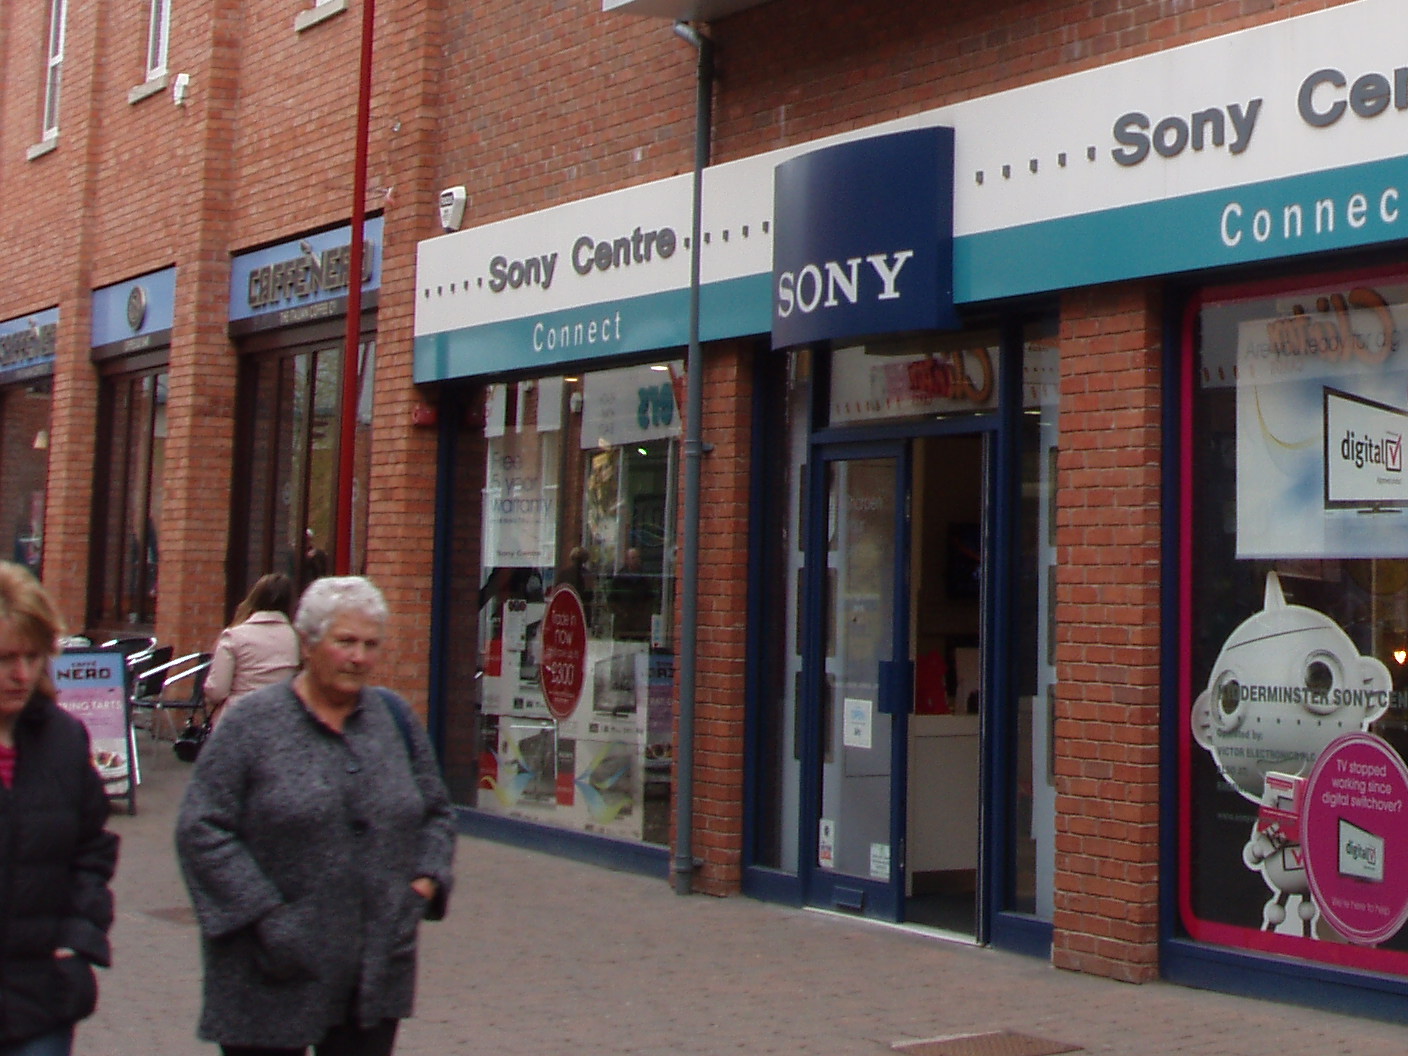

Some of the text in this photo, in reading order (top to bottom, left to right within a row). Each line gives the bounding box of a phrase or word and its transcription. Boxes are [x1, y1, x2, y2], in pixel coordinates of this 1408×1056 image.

[1111, 98, 1262, 167] Sony
[489, 226, 677, 293] Sony Centre
[778, 250, 913, 318] SONY
[533, 311, 622, 352] Connect
[1341, 430, 1385, 469] digital
[57, 668, 111, 680] NERO
[1333, 687, 1375, 709] SONY
[1337, 759, 1387, 777] TV stopped
[1331, 777, 1393, 795] working since
[1321, 792, 1403, 812] digital switchover?
